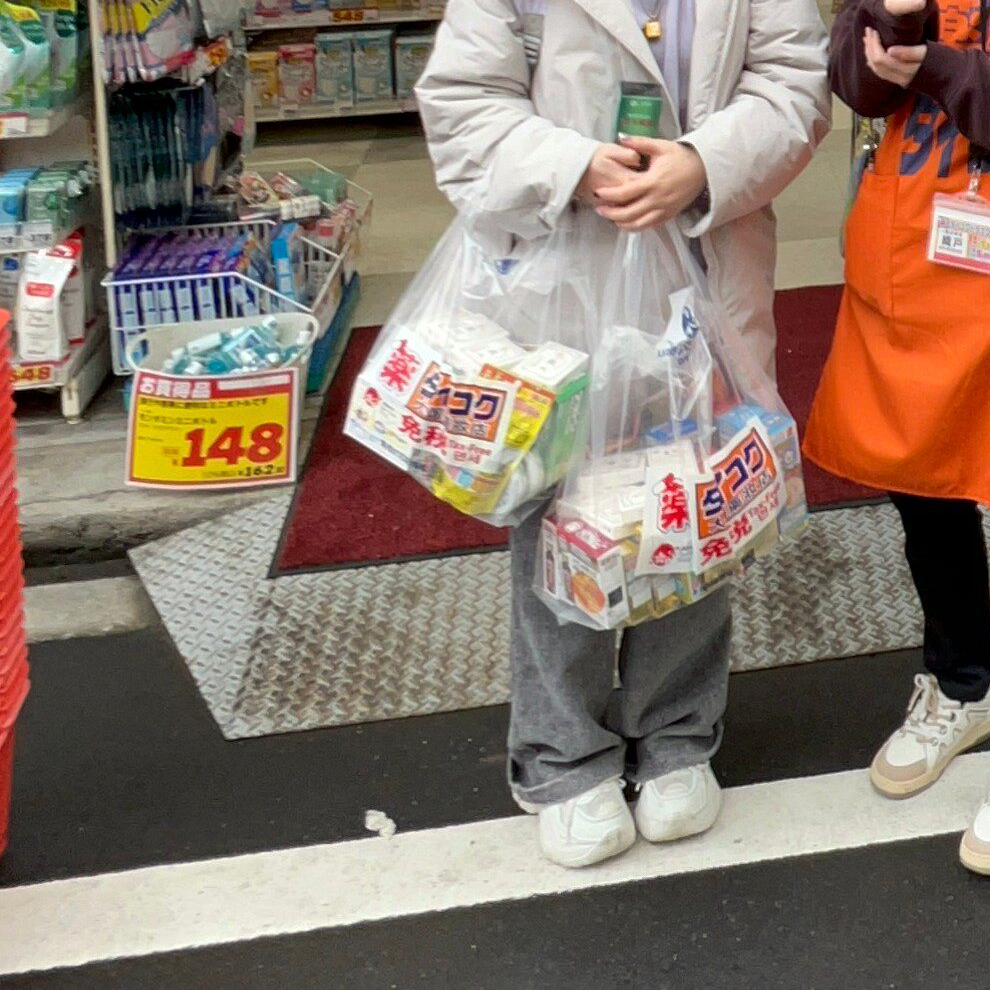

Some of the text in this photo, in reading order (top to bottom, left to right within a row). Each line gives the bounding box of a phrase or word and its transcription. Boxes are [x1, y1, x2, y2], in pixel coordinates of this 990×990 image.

[420, 372, 500, 421] ダイコク
[181, 422, 284, 468] 148
[702, 438, 764, 517] ダイコク
